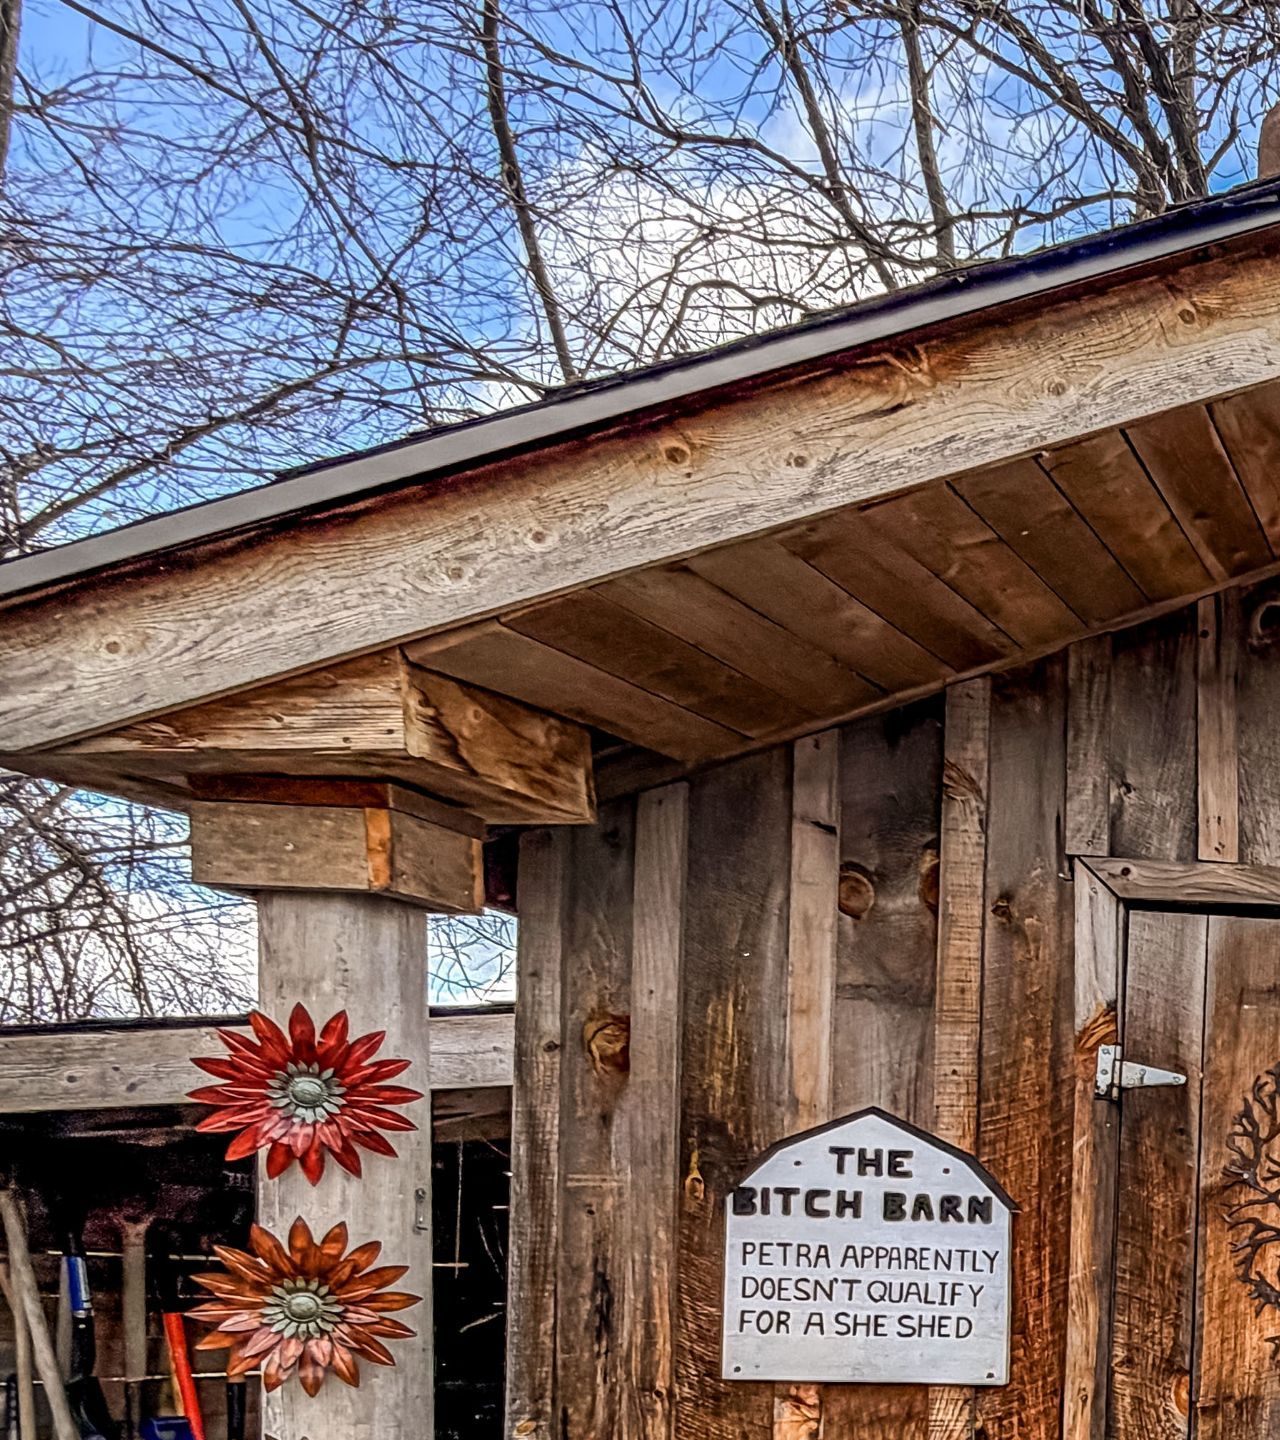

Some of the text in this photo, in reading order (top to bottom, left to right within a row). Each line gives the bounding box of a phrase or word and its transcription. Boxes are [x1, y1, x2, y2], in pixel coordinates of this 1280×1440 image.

[828, 1145, 914, 1179] THE
[731, 1186, 994, 1225] BITCH BARN
[741, 1241, 1000, 1274] PETRA APPARENTLY
[741, 1276, 985, 1308] DOESN'T QUALIFY
[738, 1309, 974, 1339] FOR A SHE SHED
